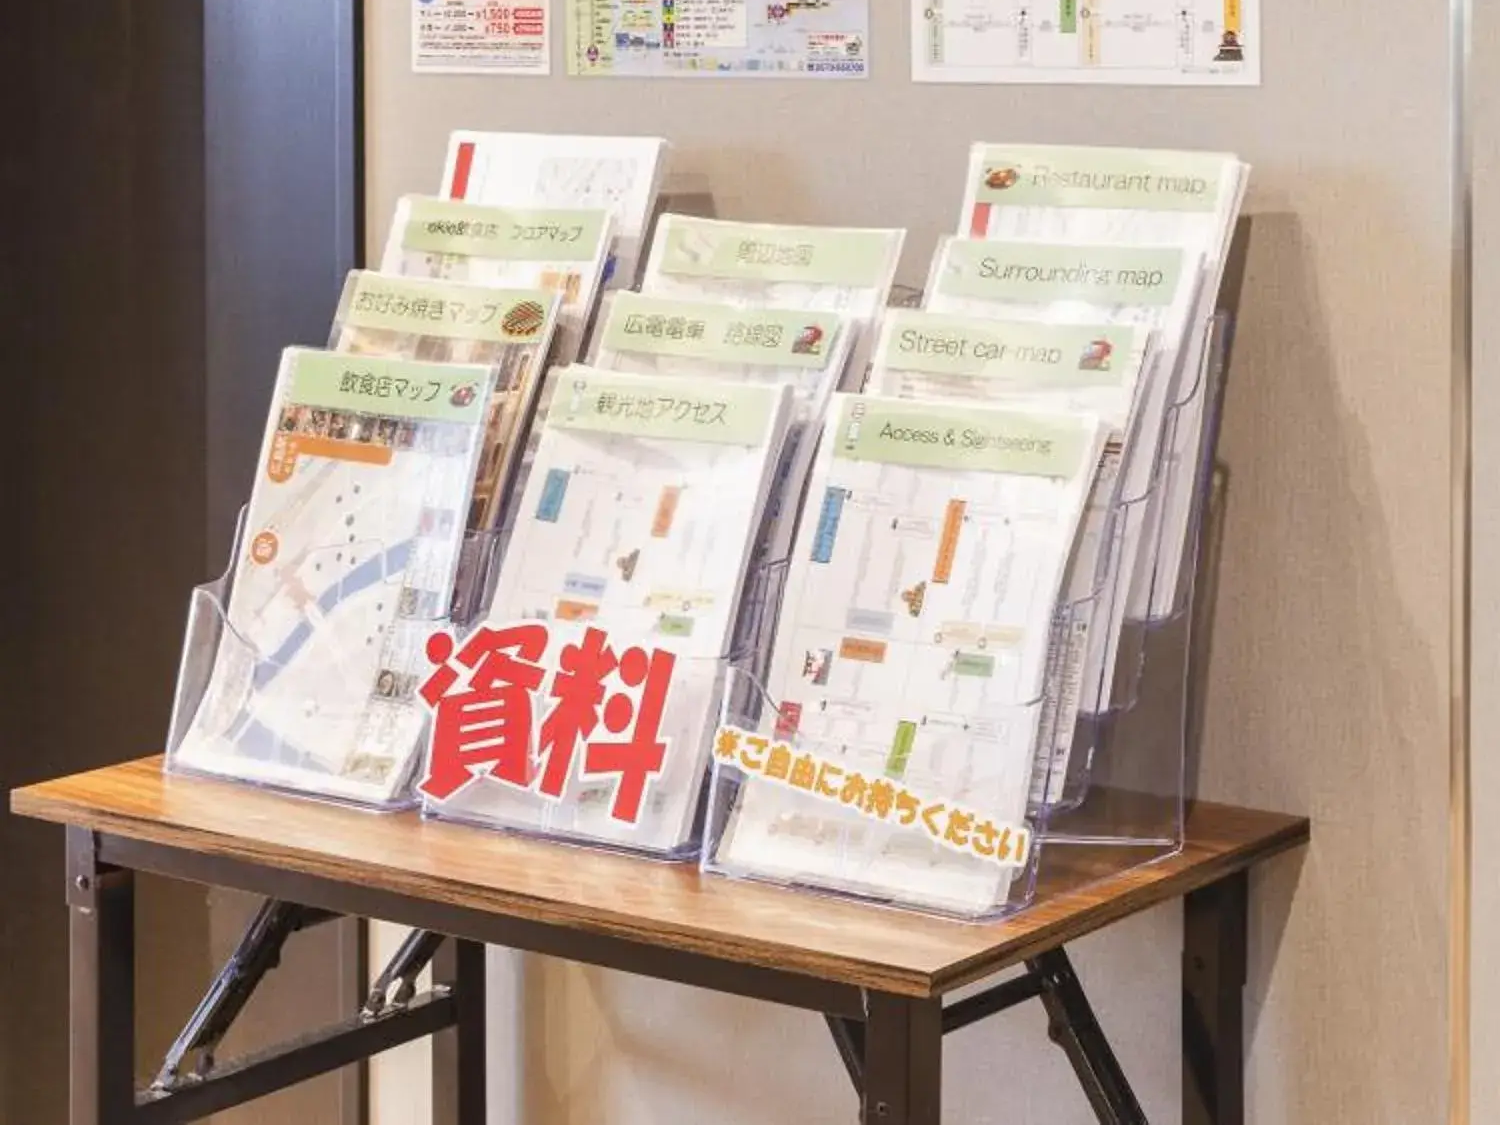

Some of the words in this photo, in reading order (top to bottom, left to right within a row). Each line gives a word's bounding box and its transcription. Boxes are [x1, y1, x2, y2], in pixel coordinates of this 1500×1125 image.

[1031, 163, 1151, 193] Restaurant
[1156, 176, 1208, 195] map
[979, 257, 1112, 284] Surrounding
[1117, 269, 1164, 287] map
[355, 290, 502, 323] お好み焼きマップ
[899, 329, 966, 354] Street
[973, 339, 1004, 359] car
[339, 370, 442, 402] 飲食店マップ
[596, 391, 728, 426] 観光地アクセス
[879, 421, 939, 444] Access
[944, 428, 956, 446] &
[418, 625, 677, 824] 資料
[716, 729, 1028, 863] ※ご自由にお持ちください
